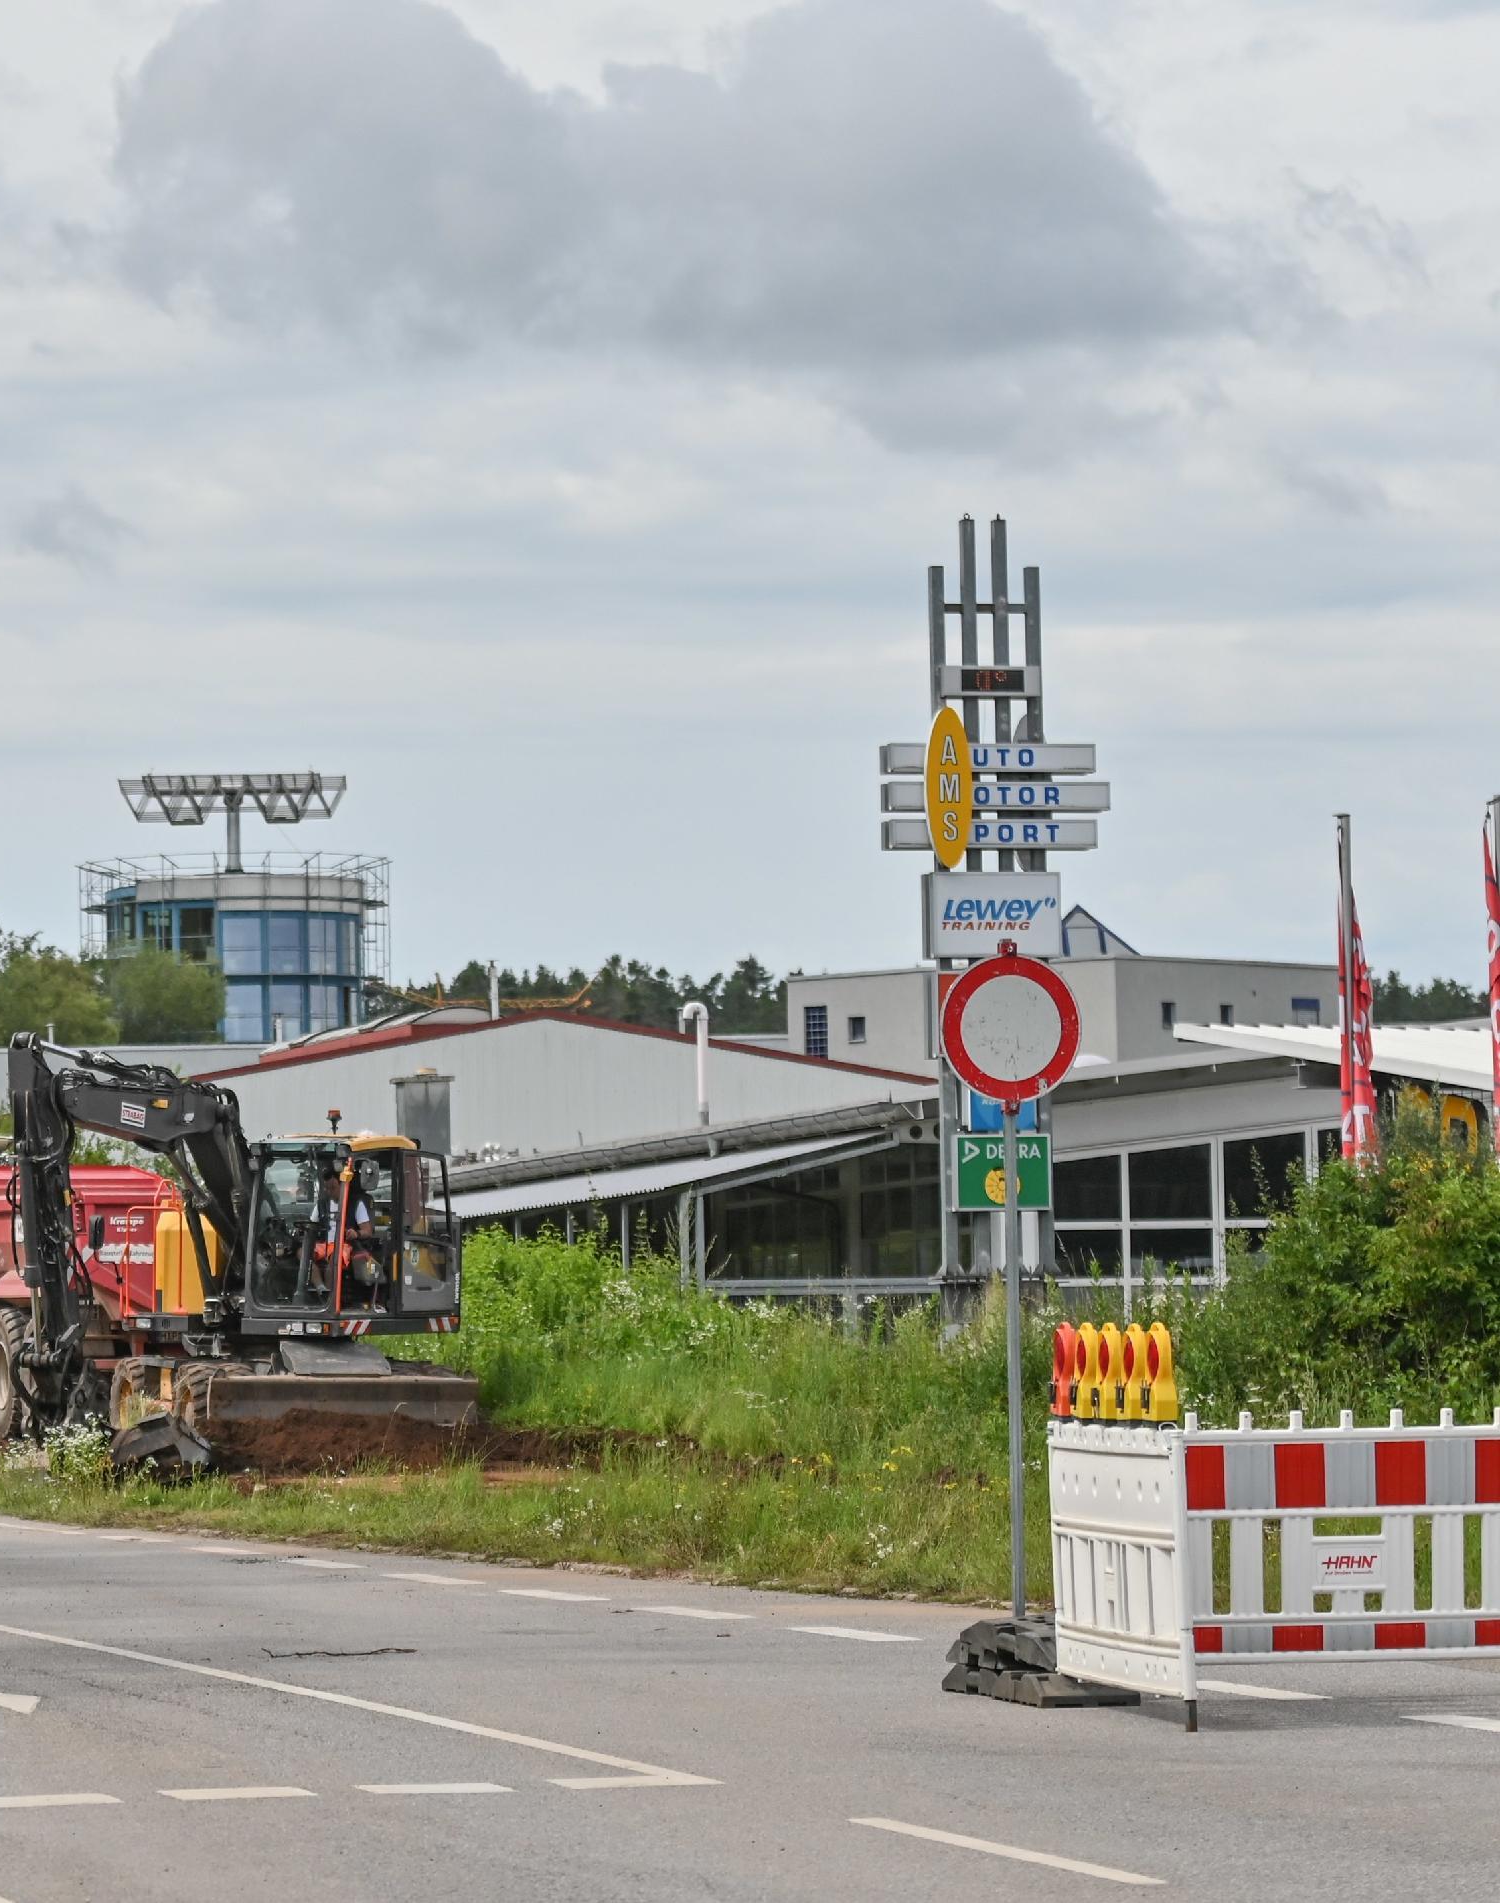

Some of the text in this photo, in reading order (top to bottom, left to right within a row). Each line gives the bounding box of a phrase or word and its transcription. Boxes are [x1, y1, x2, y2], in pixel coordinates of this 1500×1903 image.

[941, 921, 1031, 931] TRAINING
[986, 1143, 1042, 1160] DERA
[1322, 1555, 1378, 1569] HAHN
